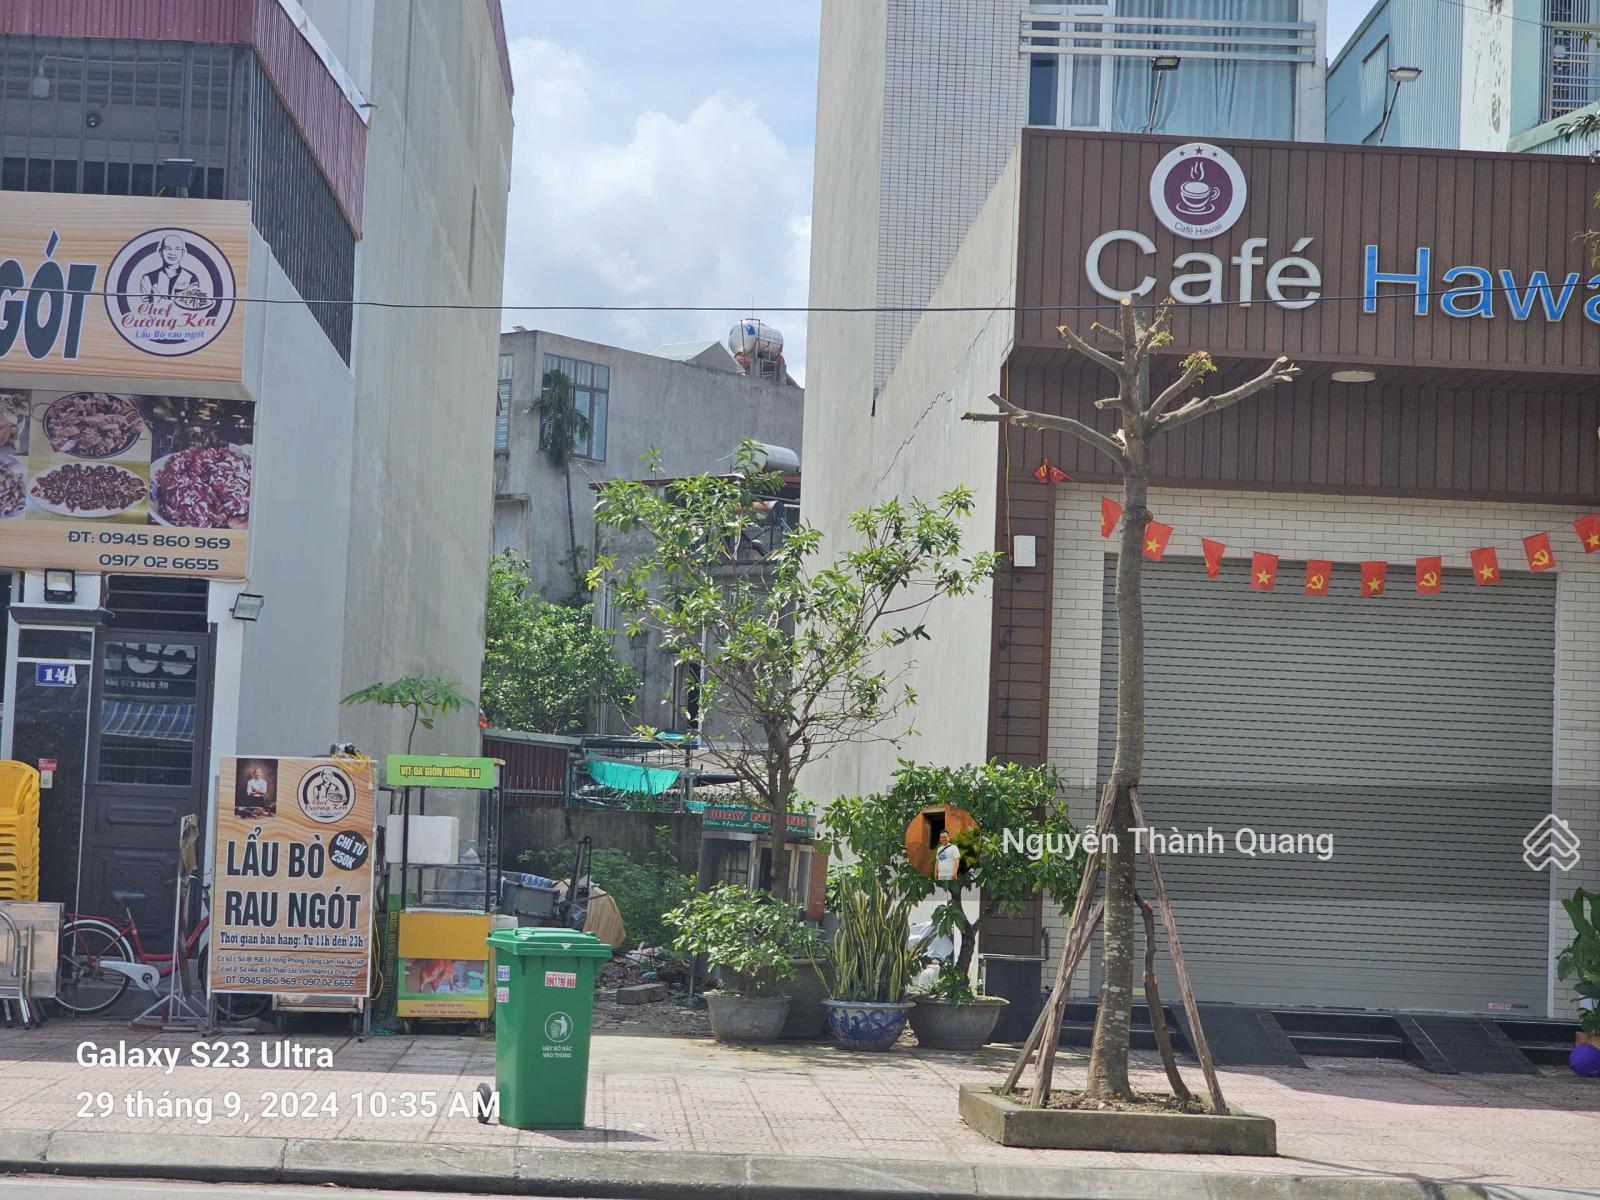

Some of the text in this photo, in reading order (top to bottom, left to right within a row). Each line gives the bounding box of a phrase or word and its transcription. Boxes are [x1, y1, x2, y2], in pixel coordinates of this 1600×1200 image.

[1085, 229, 1322, 310] Café
[138, 302, 172, 318] Chef
[178, 312, 217, 327] Ken
[68, 531, 231, 550] ĐT: 0945 860 969
[99, 553, 219, 571] 0917 02 6655
[44, 665, 77, 685] 14A
[335, 833, 353, 852] CHỈ
[227, 826, 326, 879] LẨU BÒ
[331, 849, 357, 869] 250K
[225, 886, 362, 930] RAU NGÓT
[316, 935, 330, 947] 11h
[349, 936, 364, 948] 23h
[240, 976, 260, 985] 0945
[262, 976, 278, 985] 860
[280, 977, 297, 985] 969
[303, 978, 321, 986] 0917
[334, 979, 355, 987] 6655
